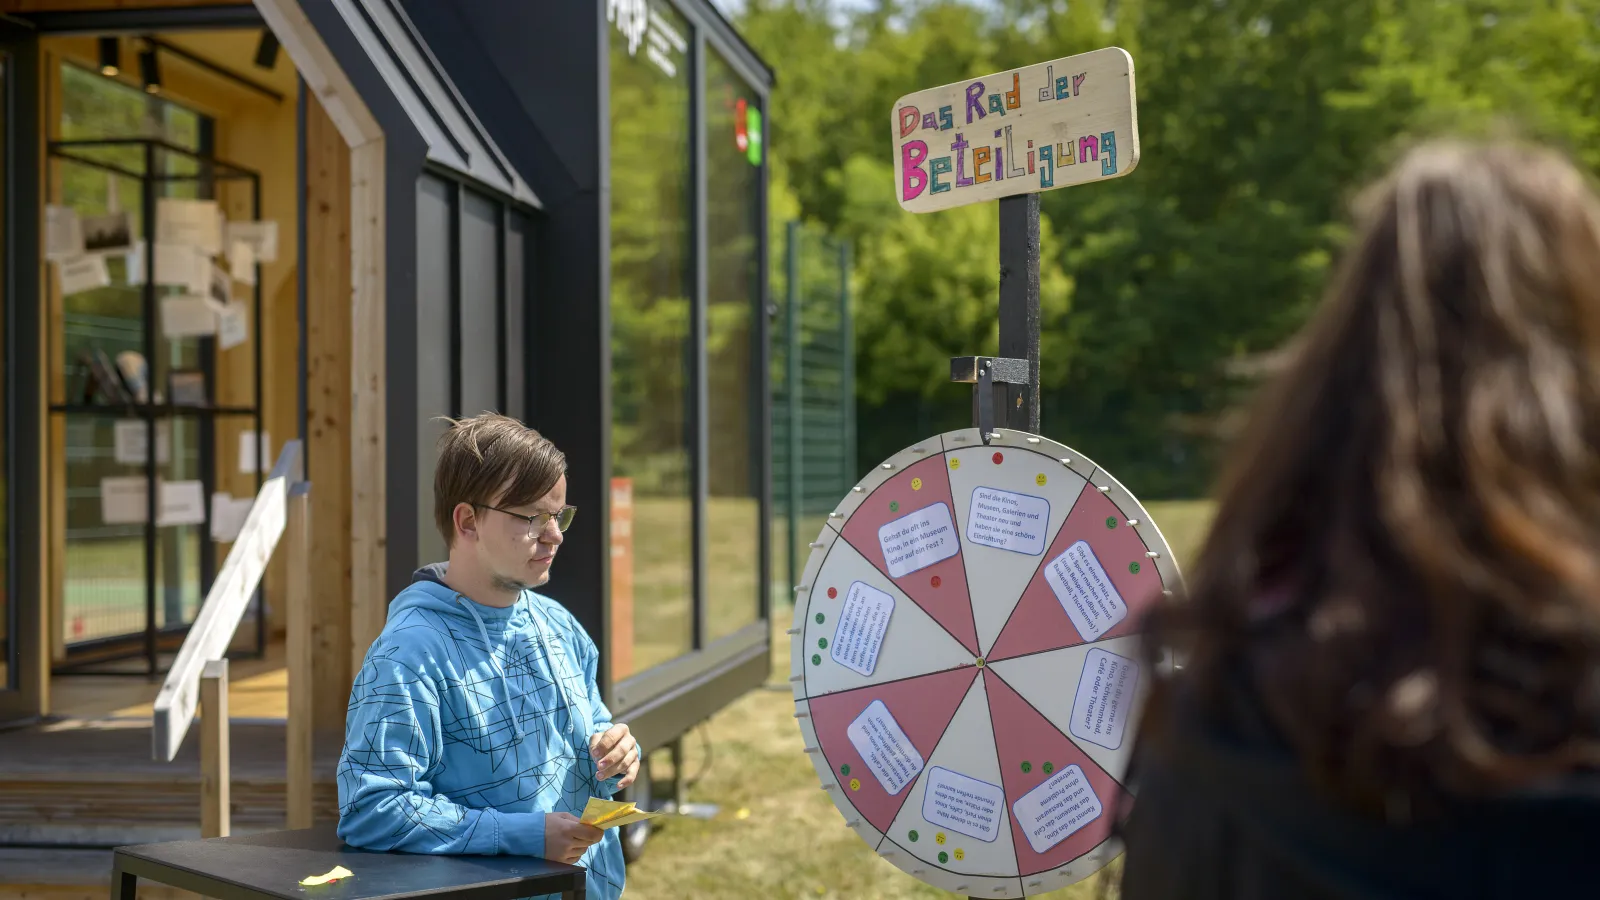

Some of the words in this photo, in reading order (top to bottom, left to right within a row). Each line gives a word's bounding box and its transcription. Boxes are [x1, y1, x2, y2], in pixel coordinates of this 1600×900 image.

[899, 104, 953, 139] Das
[965, 72, 1021, 124] Rad
[1038, 65, 1087, 102] der
[979, 492, 991, 500] Sind
[976, 513, 997, 522] Theater
[1002, 507, 1026, 517] Galerien
[883, 531, 901, 543] Gehst
[901, 527, 910, 536] du
[910, 523, 919, 532] oft
[920, 519, 930, 528] ins
[909, 536, 919, 545] ein
[920, 524, 947, 541] Museum
[973, 533, 1007, 545] Einrichtung?
[975, 523, 992, 531] haben
[1015, 531, 1036, 540] schöne
[890, 554, 904, 565] oder
[904, 550, 914, 559] auf
[915, 545, 925, 555] ein
[925, 540, 939, 550] Fest
[1059, 557, 1073, 574] (zum
[1068, 572, 1086, 597] Beispiel
[1068, 551, 1076, 561] du
[1072, 559, 1087, 578] Sport
[1083, 575, 1100, 600] machen
[1097, 599, 1113, 620] kannst
[1076, 545, 1087, 560] Gibt
[1084, 559, 1090, 567] es
[1088, 565, 1102, 583] einen
[1108, 599, 1117, 610] wo
[1071, 594, 1097, 630] Tischtennis)
[1098, 657, 1107, 675] Café
[1118, 664, 1129, 688] Gehst
[1093, 676, 1102, 695] oder
[1115, 688, 1123, 699] du
[1084, 695, 1098, 730] Theater?
[1108, 699, 1118, 722] gerne
[1106, 724, 1114, 736] ins
[1047, 769, 1075, 790] betreten?
[1064, 778, 1080, 791] ohne
[1040, 787, 1066, 808] Probleme
[1062, 794, 1074, 805] das
[1073, 787, 1085, 798] und
[1079, 796, 1091, 807] das
[1035, 801, 1064, 823] Restaurant
[1076, 805, 1096, 821] Kannst
[1045, 819, 1056, 829] das
[1058, 822, 1069, 833] das
[1068, 817, 1077, 826] du
[1033, 825, 1046, 837] Café
